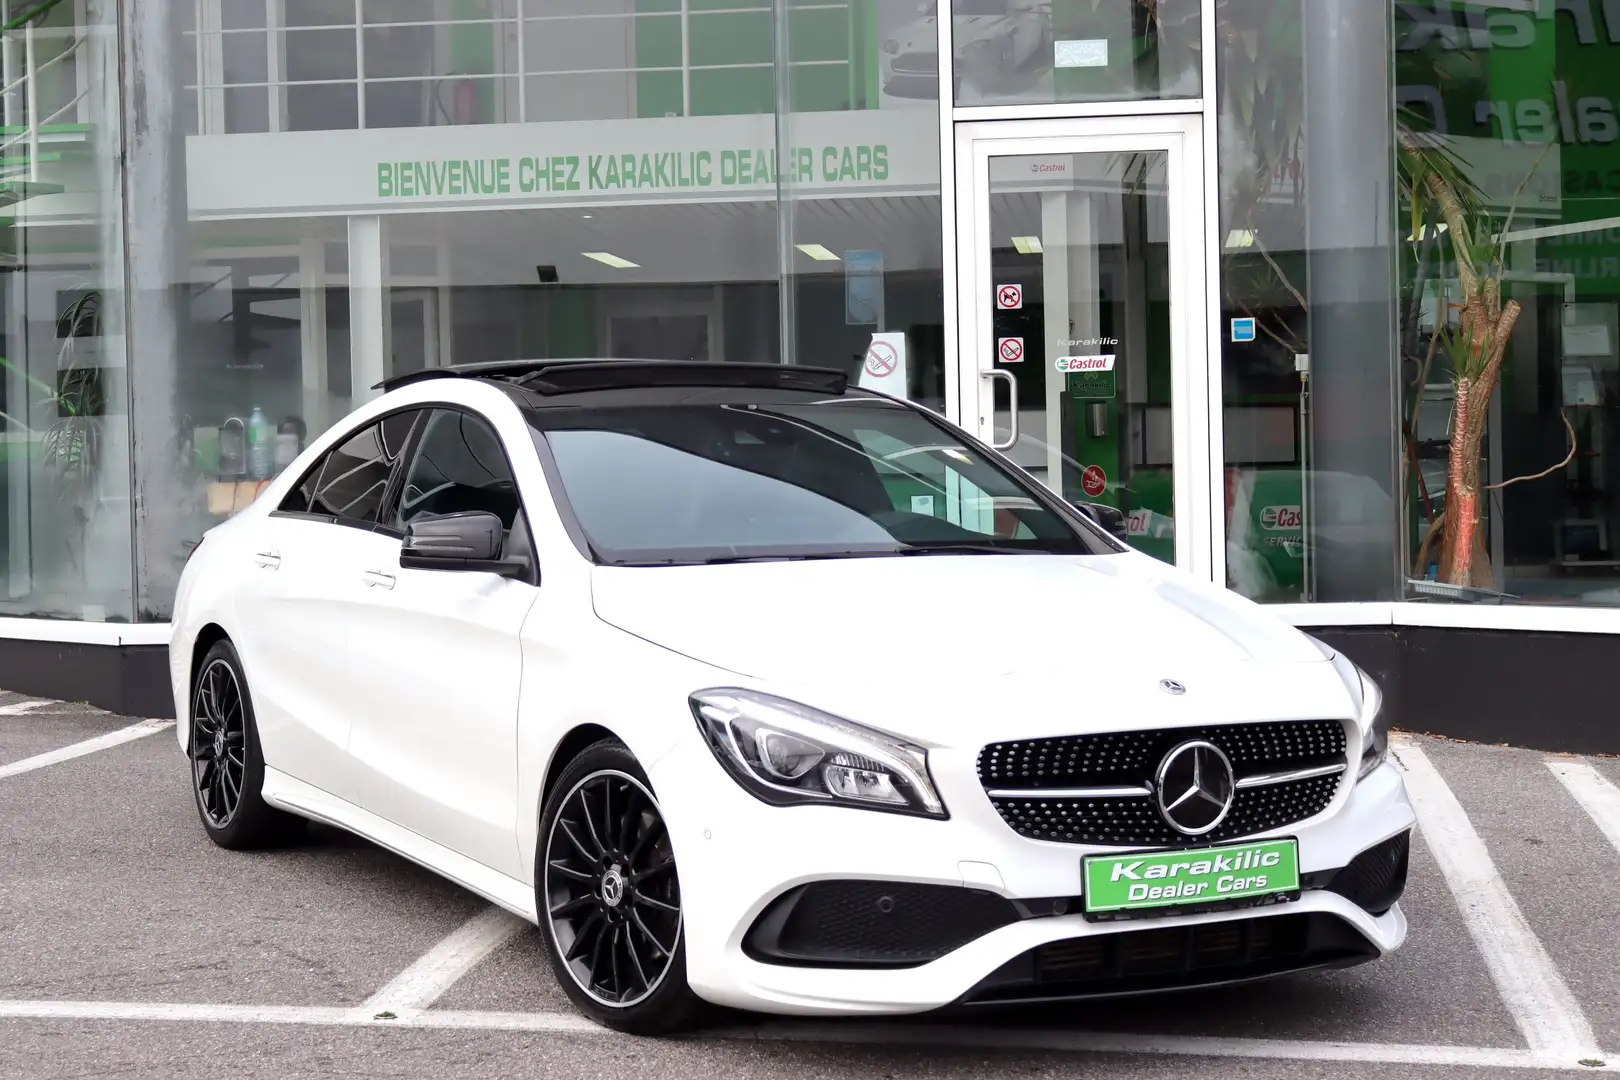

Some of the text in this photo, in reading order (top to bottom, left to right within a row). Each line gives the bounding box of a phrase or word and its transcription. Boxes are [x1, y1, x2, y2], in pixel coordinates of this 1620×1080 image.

[377, 144, 889, 197] BIENVENUE CHEZ KARAKILIC DEALER CARS
[1039, 163, 1066, 173] Castrol
[1056, 337, 1119, 346] Karakilic
[1069, 357, 1107, 370] Castrol
[1110, 849, 1281, 882] Karakilic
[1128, 874, 1268, 902] Dealer Cars
